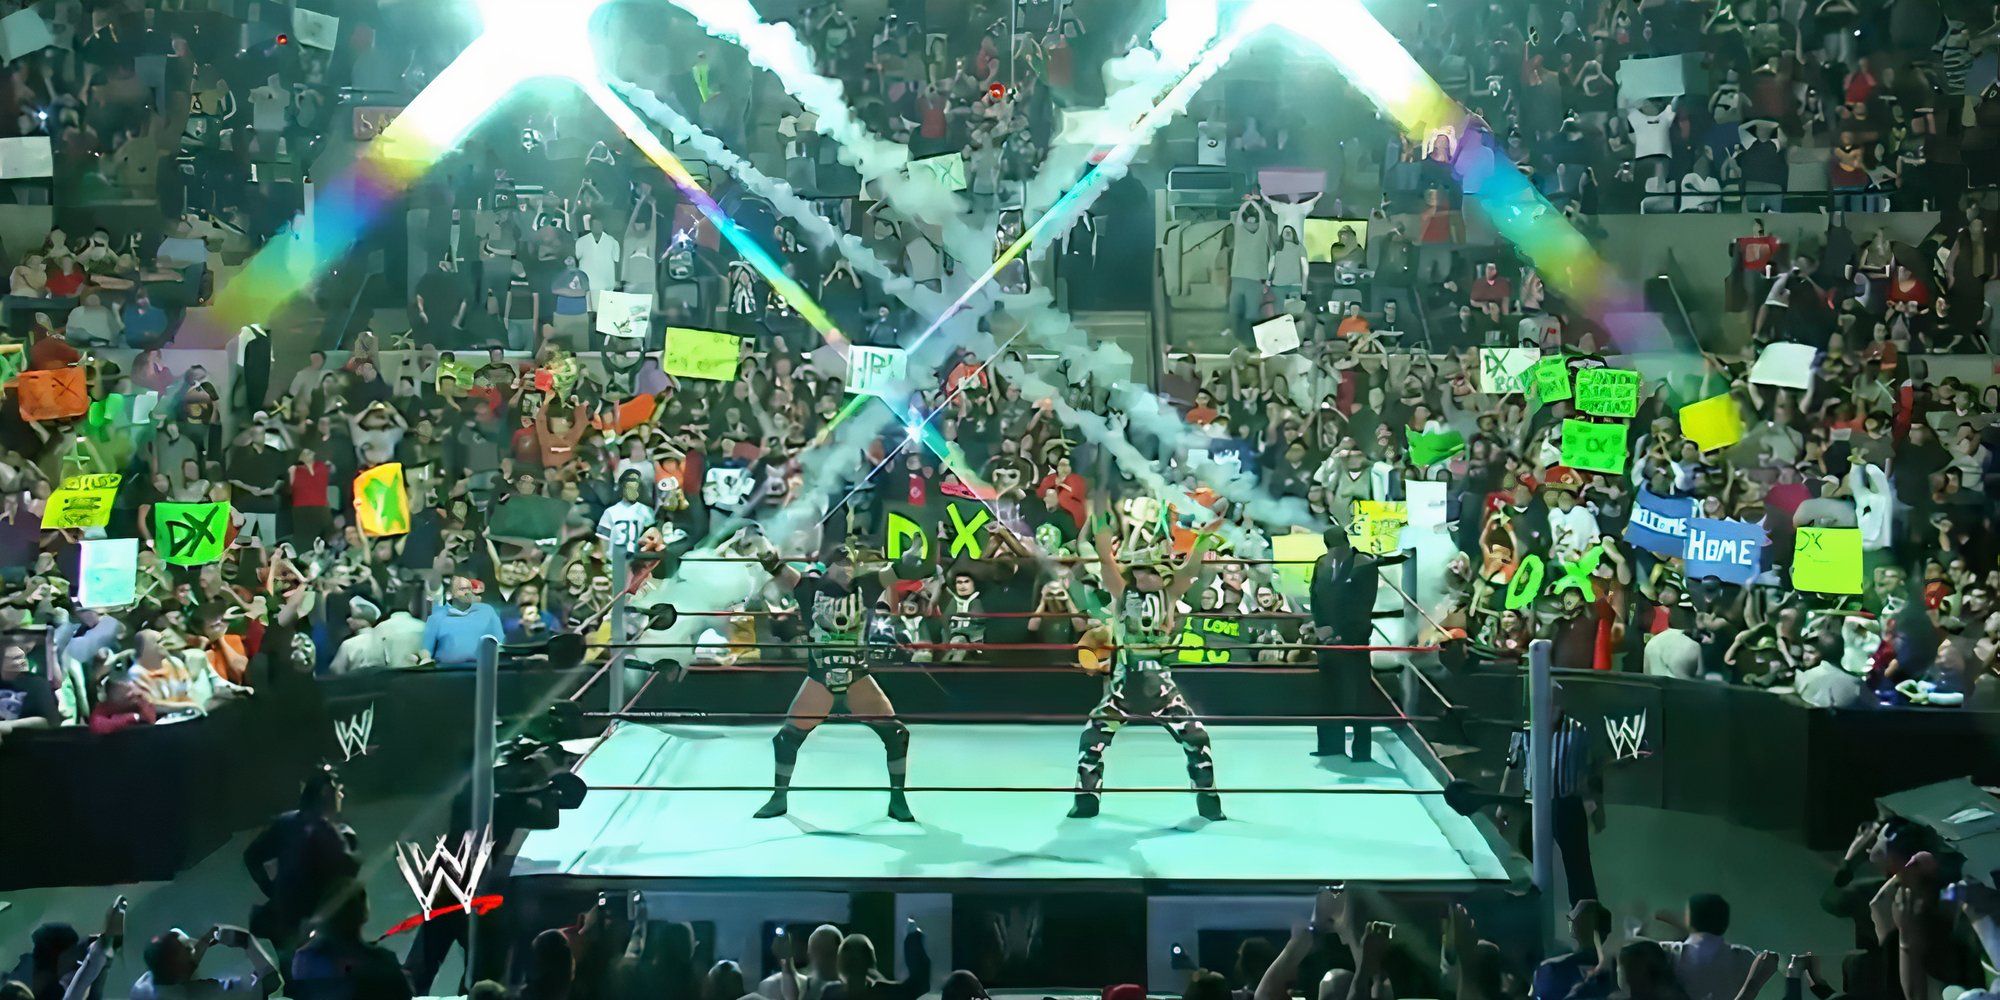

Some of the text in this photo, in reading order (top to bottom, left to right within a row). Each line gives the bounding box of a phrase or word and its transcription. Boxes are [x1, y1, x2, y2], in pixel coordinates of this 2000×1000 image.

[1484, 347, 1510, 378] DX
[165, 505, 219, 557] DX
[1688, 528, 1756, 566] HOME
